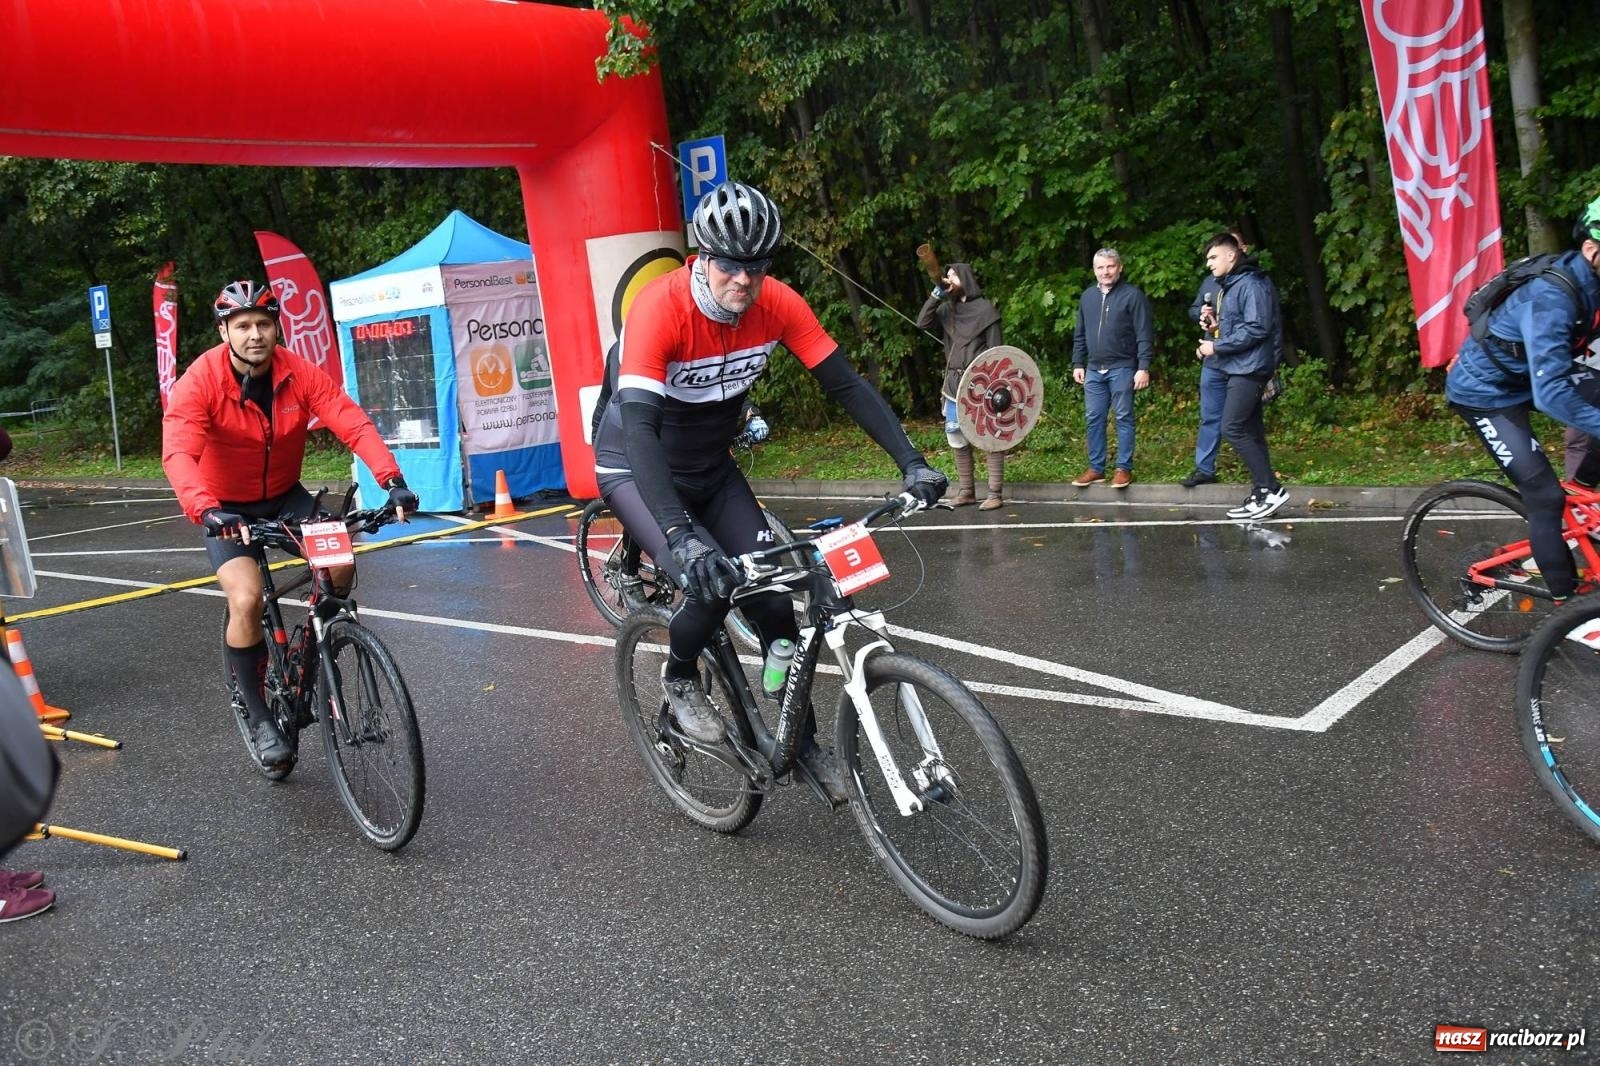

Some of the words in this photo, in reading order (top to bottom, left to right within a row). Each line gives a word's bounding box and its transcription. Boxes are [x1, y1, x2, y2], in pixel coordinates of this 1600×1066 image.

[690, 146, 717, 196] P
[454, 275, 513, 289] PersonalBest
[93, 291, 105, 319] P
[314, 537, 341, 551] 36
[843, 548, 862, 567] 3
